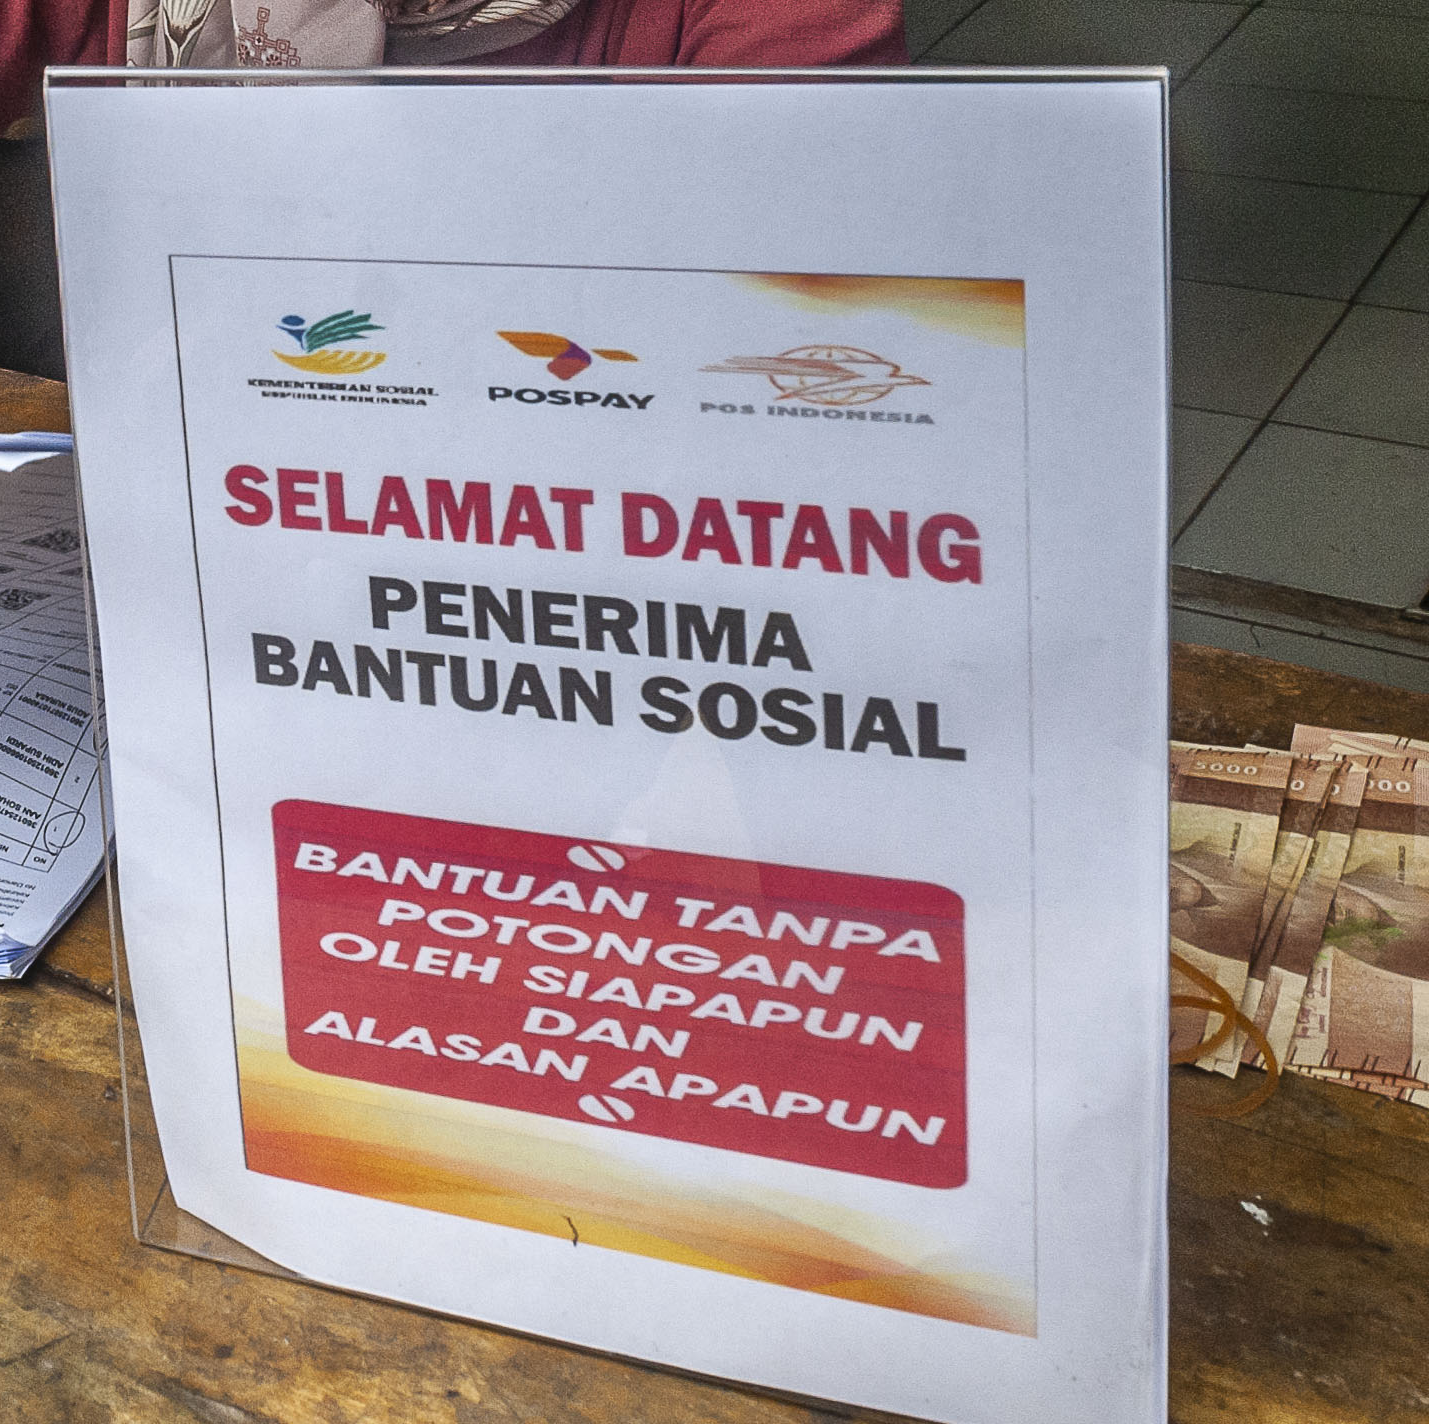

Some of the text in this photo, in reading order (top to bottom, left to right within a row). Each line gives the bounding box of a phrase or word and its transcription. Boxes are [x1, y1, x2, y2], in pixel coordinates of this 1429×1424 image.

[375, 384, 439, 398] SOSIAL
[487, 385, 655, 412] POSPAY
[699, 401, 936, 426] POS INDONESIA
[222, 462, 984, 585] SELAMAT DATANG
[368, 575, 812, 673] PENERIMA
[251, 632, 967, 762] BANTUAN SOSIAL
[6, 735, 43, 761] SUPARDI
[42, 754, 64, 768] ADIH
[1196, 761, 1258, 775] 5000
[21, 806, 41, 819] AAN
[33, 856, 48, 864] NO
[291, 843, 942, 963] BANTUAN TANPA
[376, 898, 845, 995] POTONGAN
[318, 931, 924, 1052] OLEH SIAPAPUN
[522, 1006, 691, 1058] DAN
[302, 1009, 947, 1146] ALASAN APAPUN
